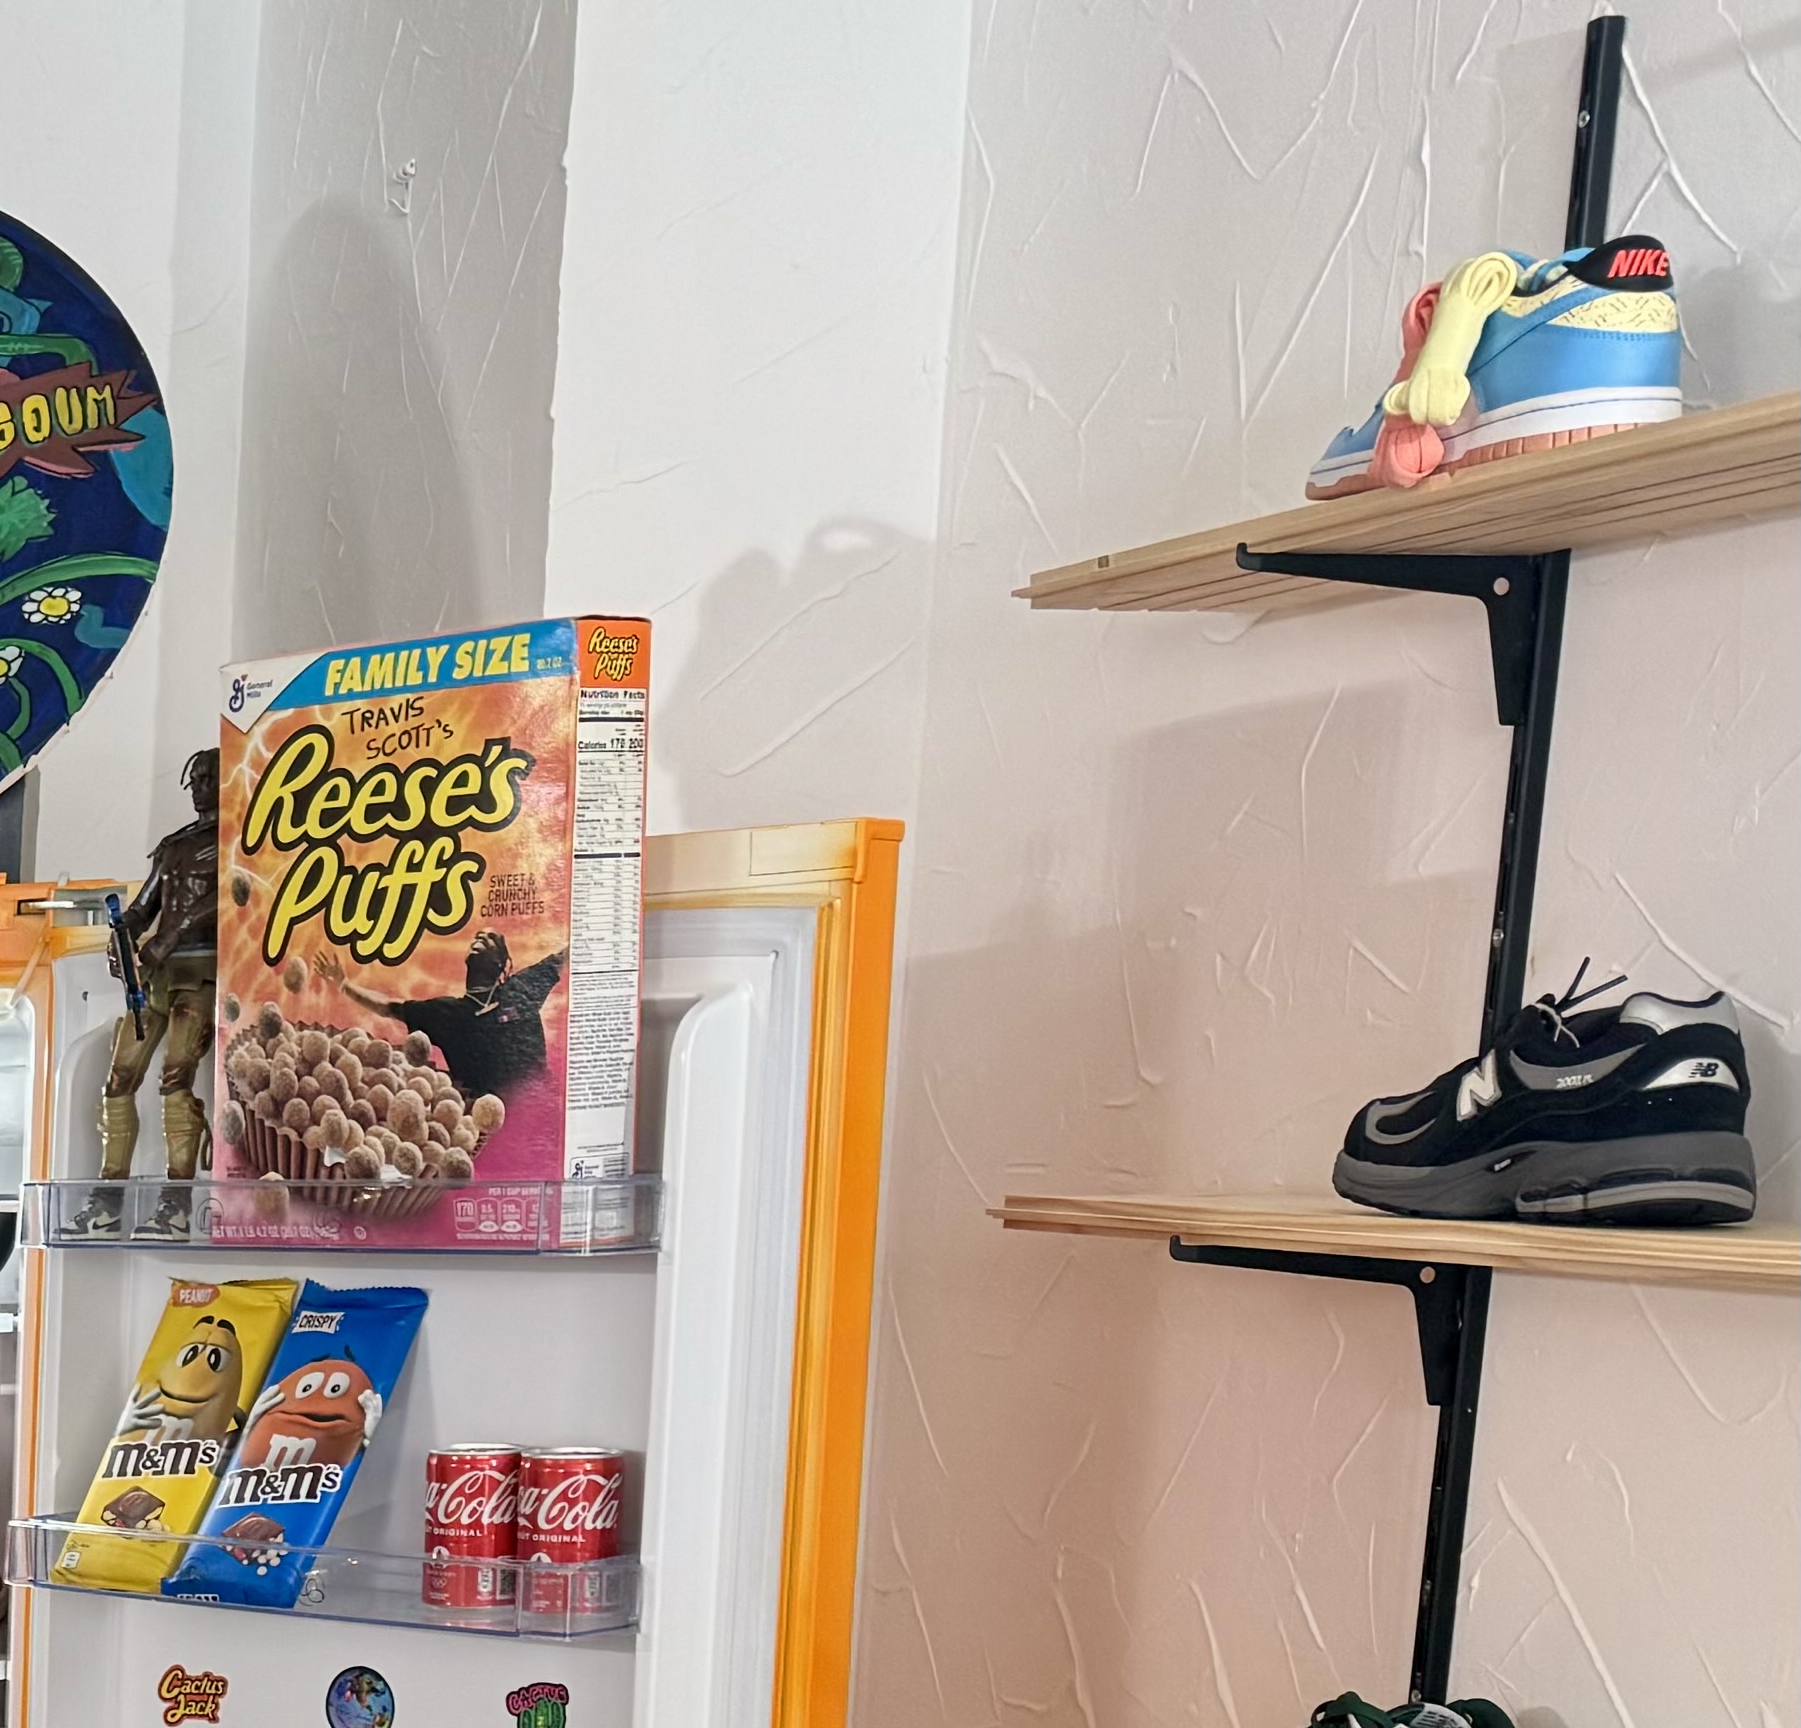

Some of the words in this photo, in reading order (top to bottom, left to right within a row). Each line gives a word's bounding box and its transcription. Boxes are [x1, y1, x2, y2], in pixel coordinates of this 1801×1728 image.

[1607, 249, 1668, 278] NIKE
[588, 627, 639, 653] Reese's
[324, 644, 450, 697] FAMILY
[452, 633, 531, 680] SIZE
[594, 653, 633, 681] Puffs
[342, 696, 425, 734] TRAVIS
[244, 728, 532, 852] Reese's
[488, 887, 537, 902] CRUNCHY
[490, 873, 525, 888] SWEET
[265, 834, 482, 963] Puffs
[481, 903, 508, 917] CORN
[511, 901, 544, 915] PUFFS
[299, 1314, 337, 1328] CRISPY
[433, 1528, 482, 1536] ORIGINAL
[532, 1534, 586, 1542] ORIGINAL
[161, 1670, 224, 1698] Cactus
[167, 1694, 215, 1722] Jack
